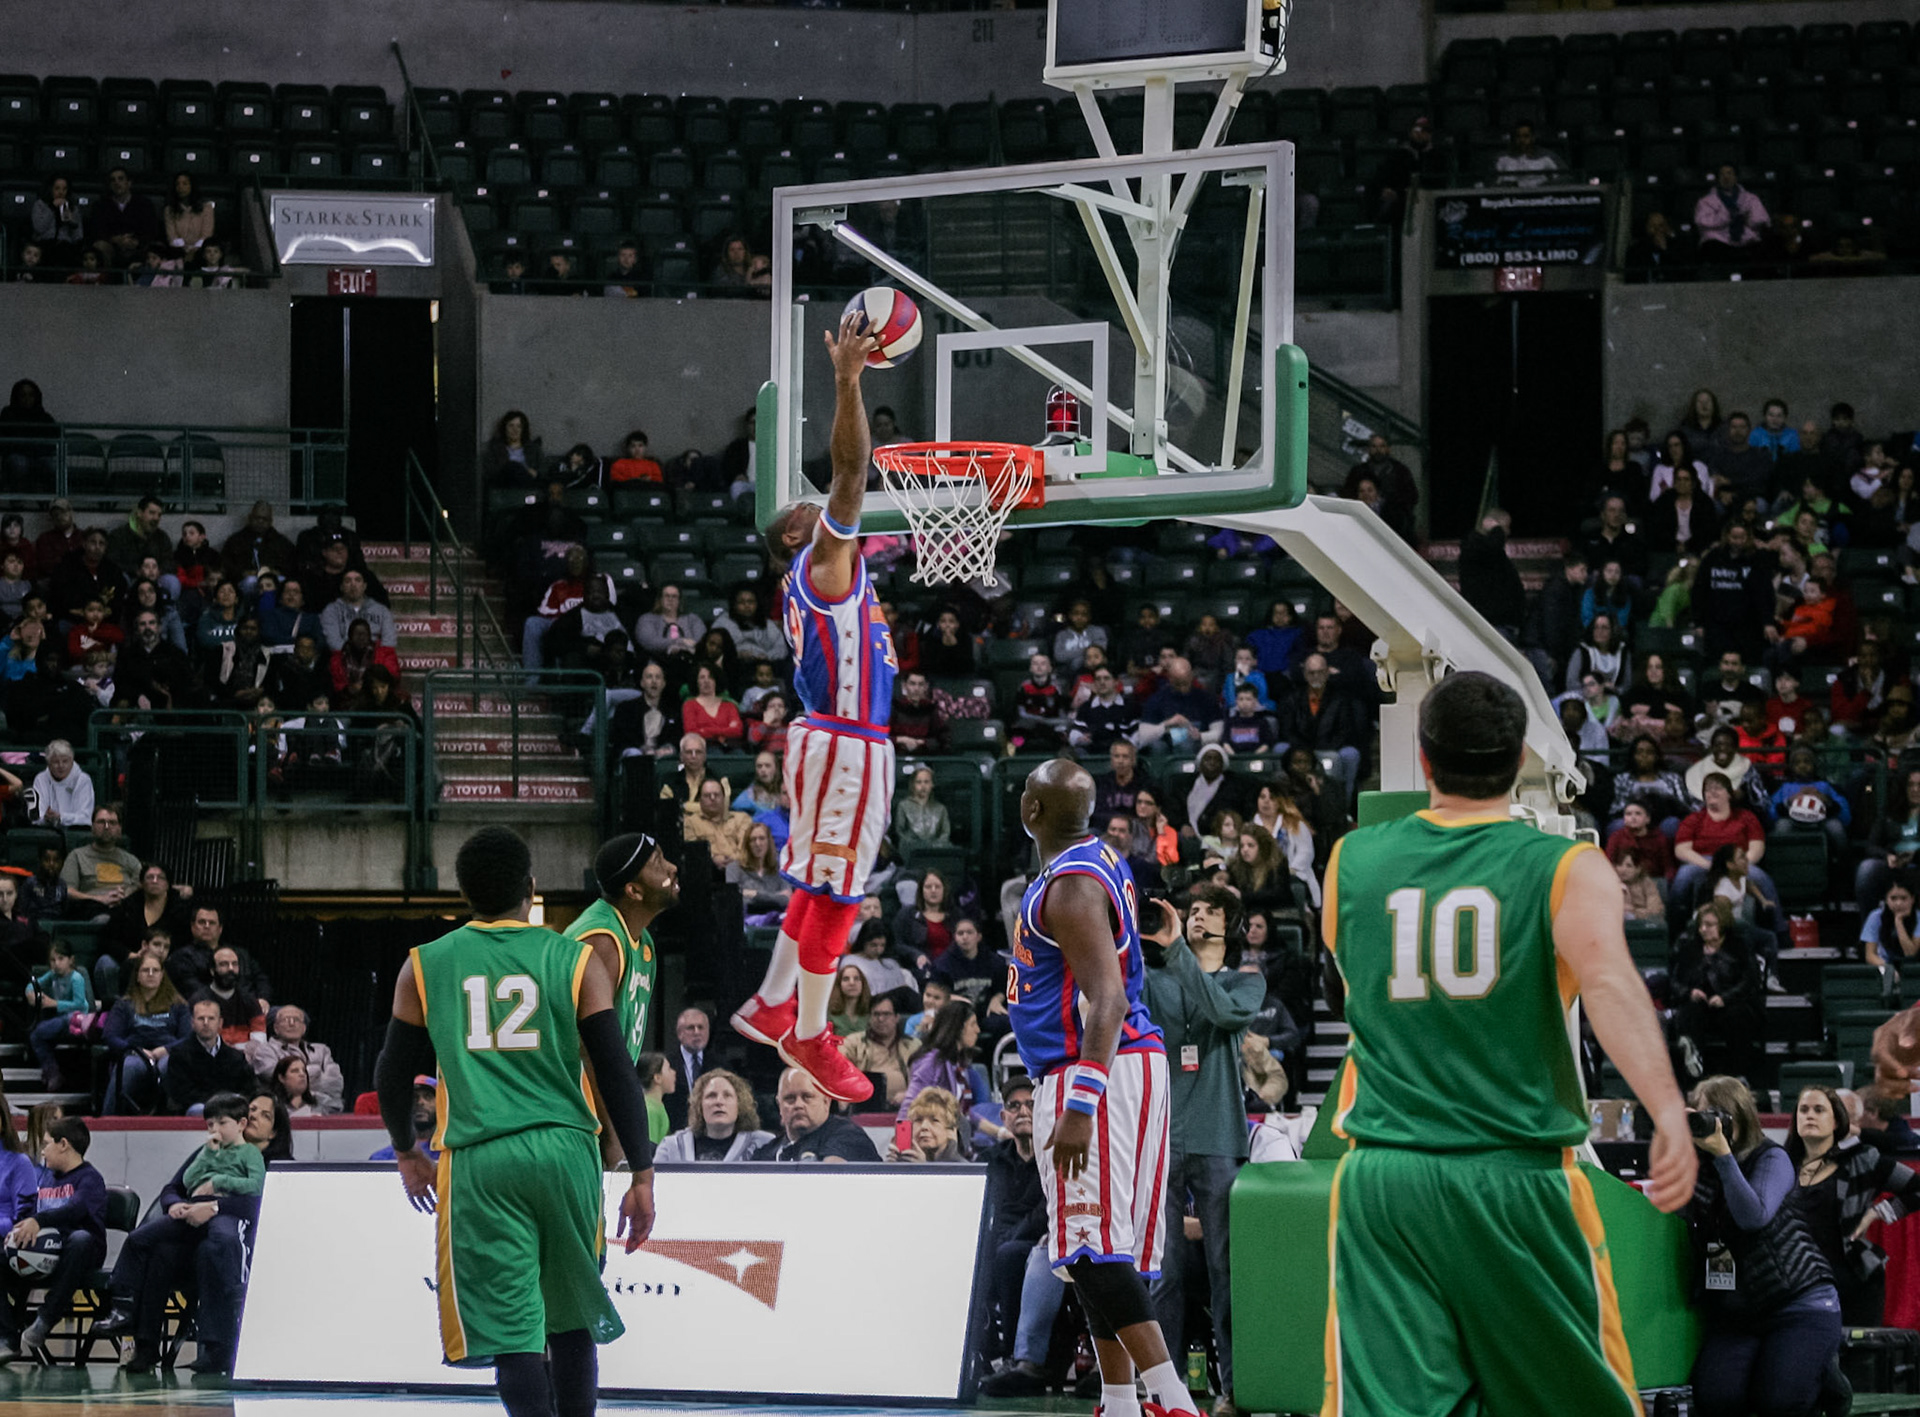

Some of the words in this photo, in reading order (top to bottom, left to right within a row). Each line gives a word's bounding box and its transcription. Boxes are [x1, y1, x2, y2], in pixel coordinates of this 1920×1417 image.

[1459, 252, 1499, 266] (800)
[339, 271, 368, 293] EXIT
[362, 546, 399, 556] OYOTA
[387, 584, 415, 594] YOTA
[395, 622, 431, 632] OYOTA
[405, 658, 449, 668] TOYOTA
[497, 703, 541, 713] TOOTA
[442, 742, 487, 752] TOYOTA
[518, 743, 562, 753] TOYOTA
[455, 785, 501, 795] TOYOTA
[531, 786, 578, 797] TOYOTA
[1385, 885, 1501, 1002] 10
[462, 974, 540, 1052] 12
